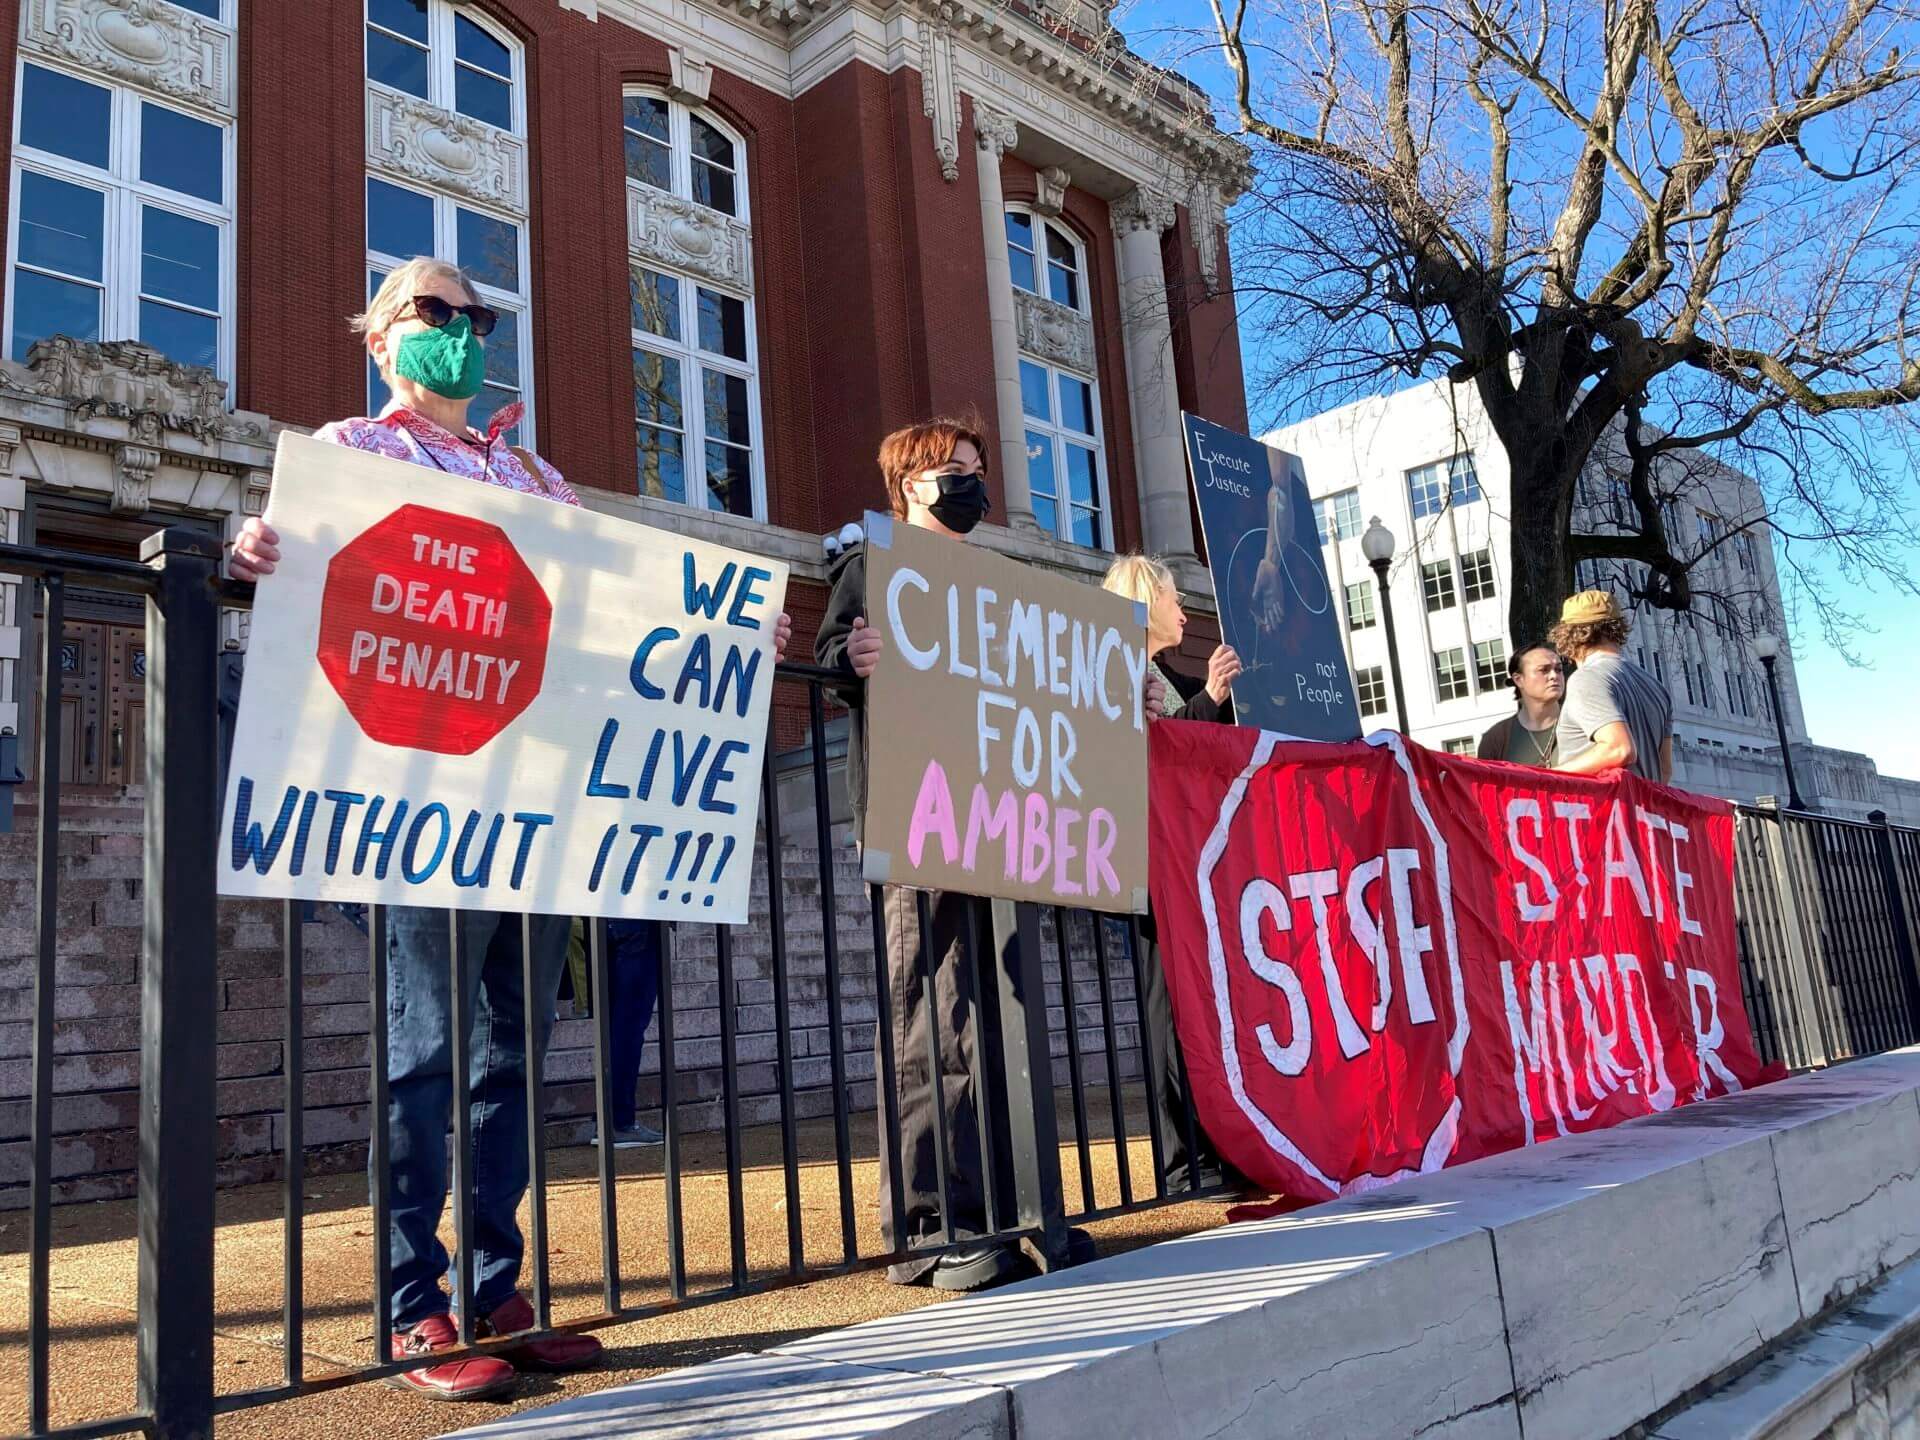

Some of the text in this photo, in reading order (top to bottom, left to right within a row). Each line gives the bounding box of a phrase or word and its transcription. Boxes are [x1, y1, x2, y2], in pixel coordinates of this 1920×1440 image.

[1194, 430, 1251, 474] Execute
[1205, 459, 1251, 498] Justice
[412, 534, 479, 575] THE
[683, 551, 772, 631] WE
[371, 574, 508, 638] DEATH
[349, 630, 521, 705] PENALTY
[629, 626, 762, 717] CAN
[886, 567, 1147, 734] CLEMENCY
[1315, 660, 1337, 678] not
[1295, 672, 1344, 716] People
[586, 718, 751, 815] LIVE
[976, 689, 1083, 799] FOR
[231, 776, 736, 908] WITHOUT IT!!!
[907, 758, 1121, 898] AMBER
[1506, 798, 1703, 937] STATE
[1499, 953, 1744, 1147] MURDR
